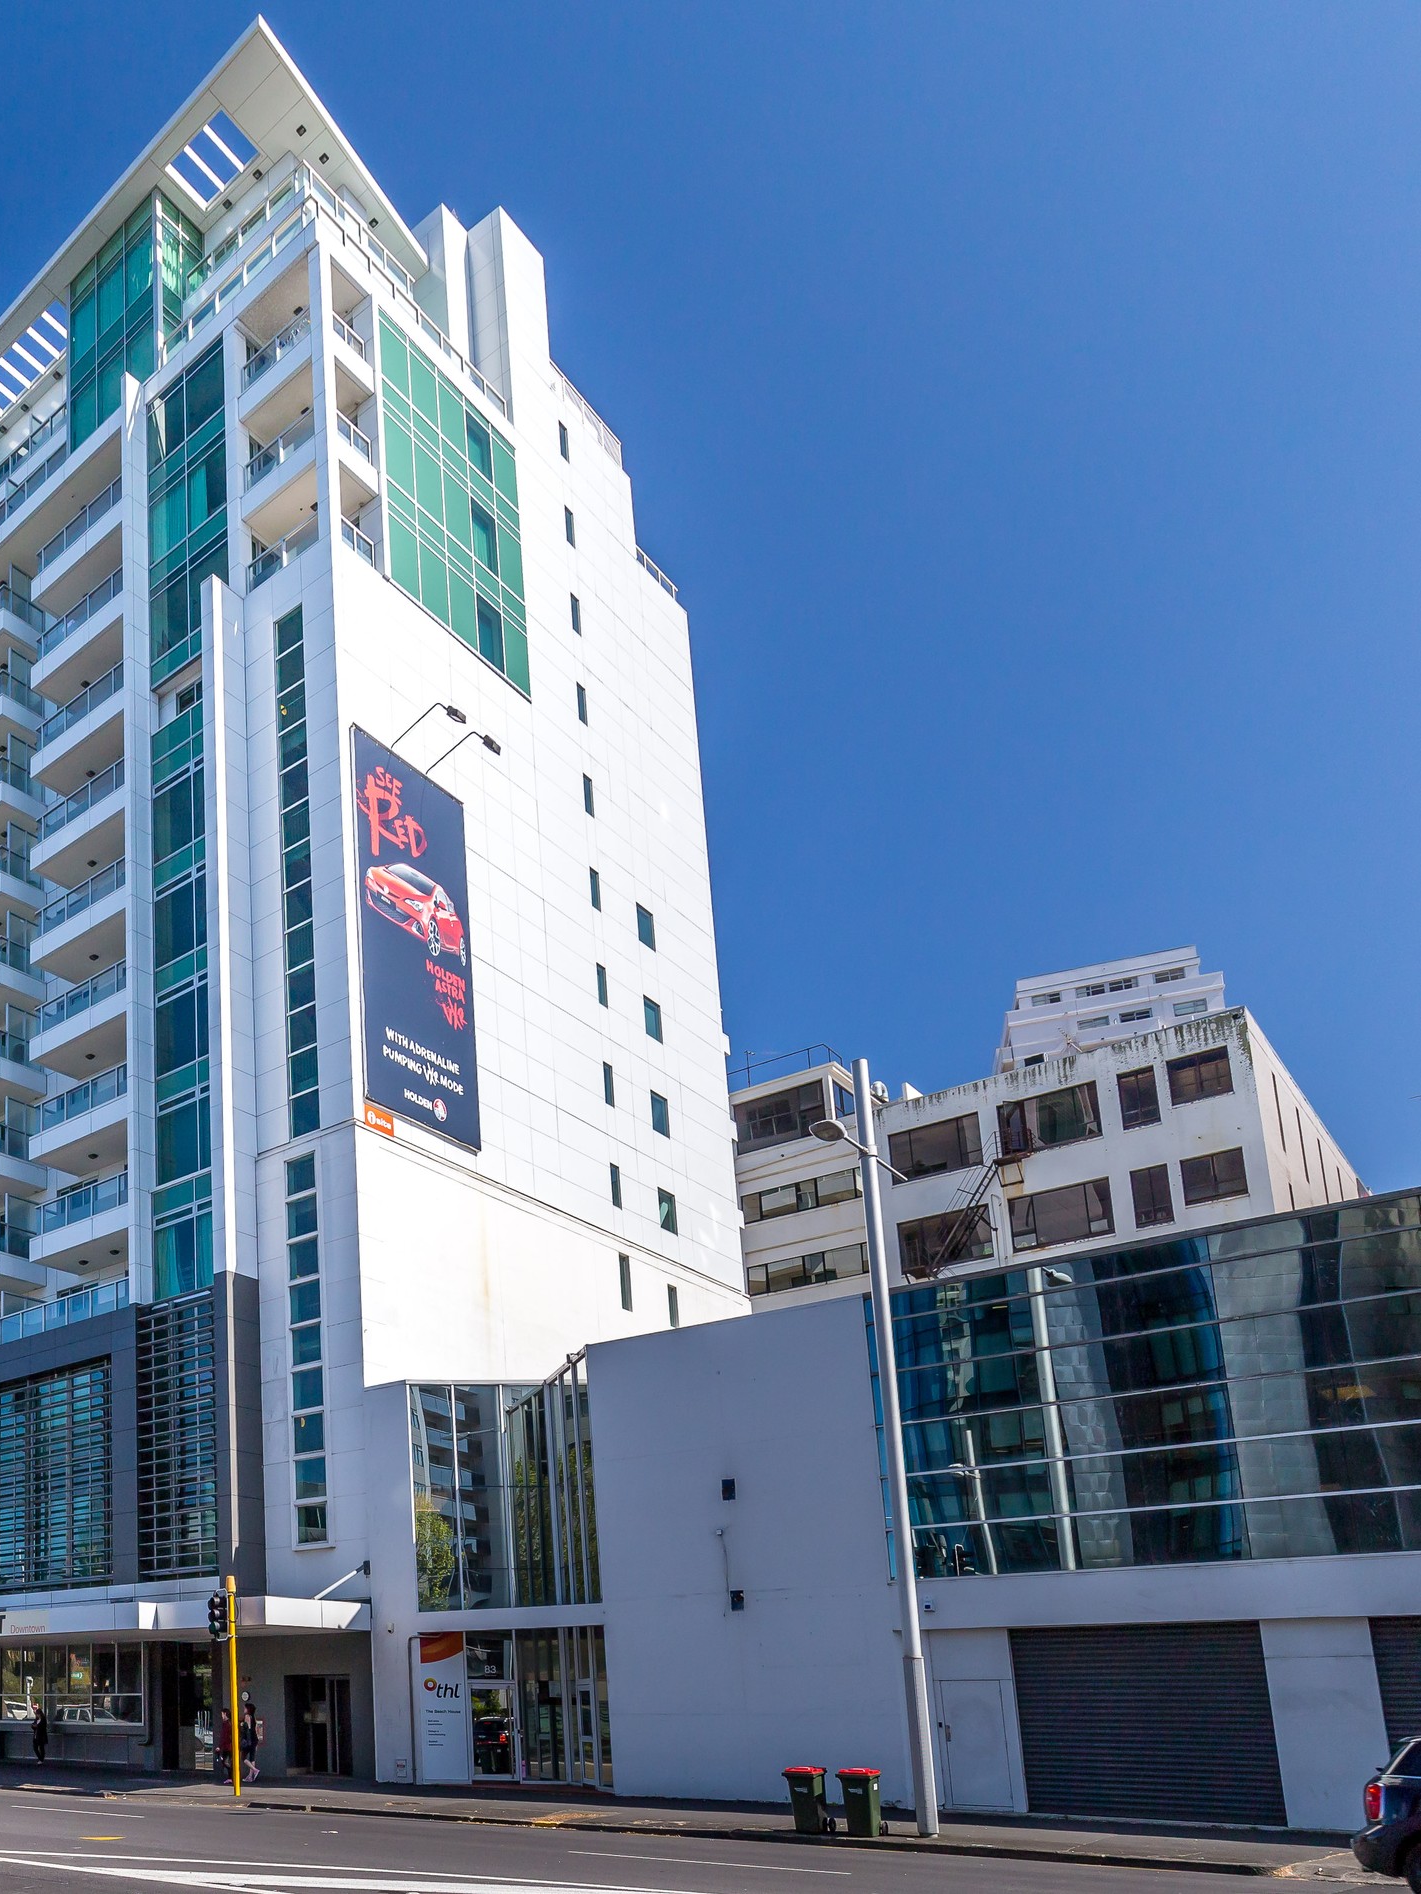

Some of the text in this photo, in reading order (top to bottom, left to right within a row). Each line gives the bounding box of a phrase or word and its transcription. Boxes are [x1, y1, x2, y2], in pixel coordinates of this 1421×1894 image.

[375, 766, 403, 806] SEE
[364, 773, 428, 859] RED
[426, 959, 467, 992] HOLDEN
[435, 979, 466, 1005] ASTRA
[385, 1026, 461, 1076] WITH ADRENALINE
[382, 1044, 423, 1075] PUMPING
[440, 1074, 465, 1096] MODE
[403, 1088, 434, 1111] HOLDEN
[11, 1623, 46, 1635] Downtown
[484, 1664, 497, 1674] 83
[436, 1683, 461, 1699] thl
